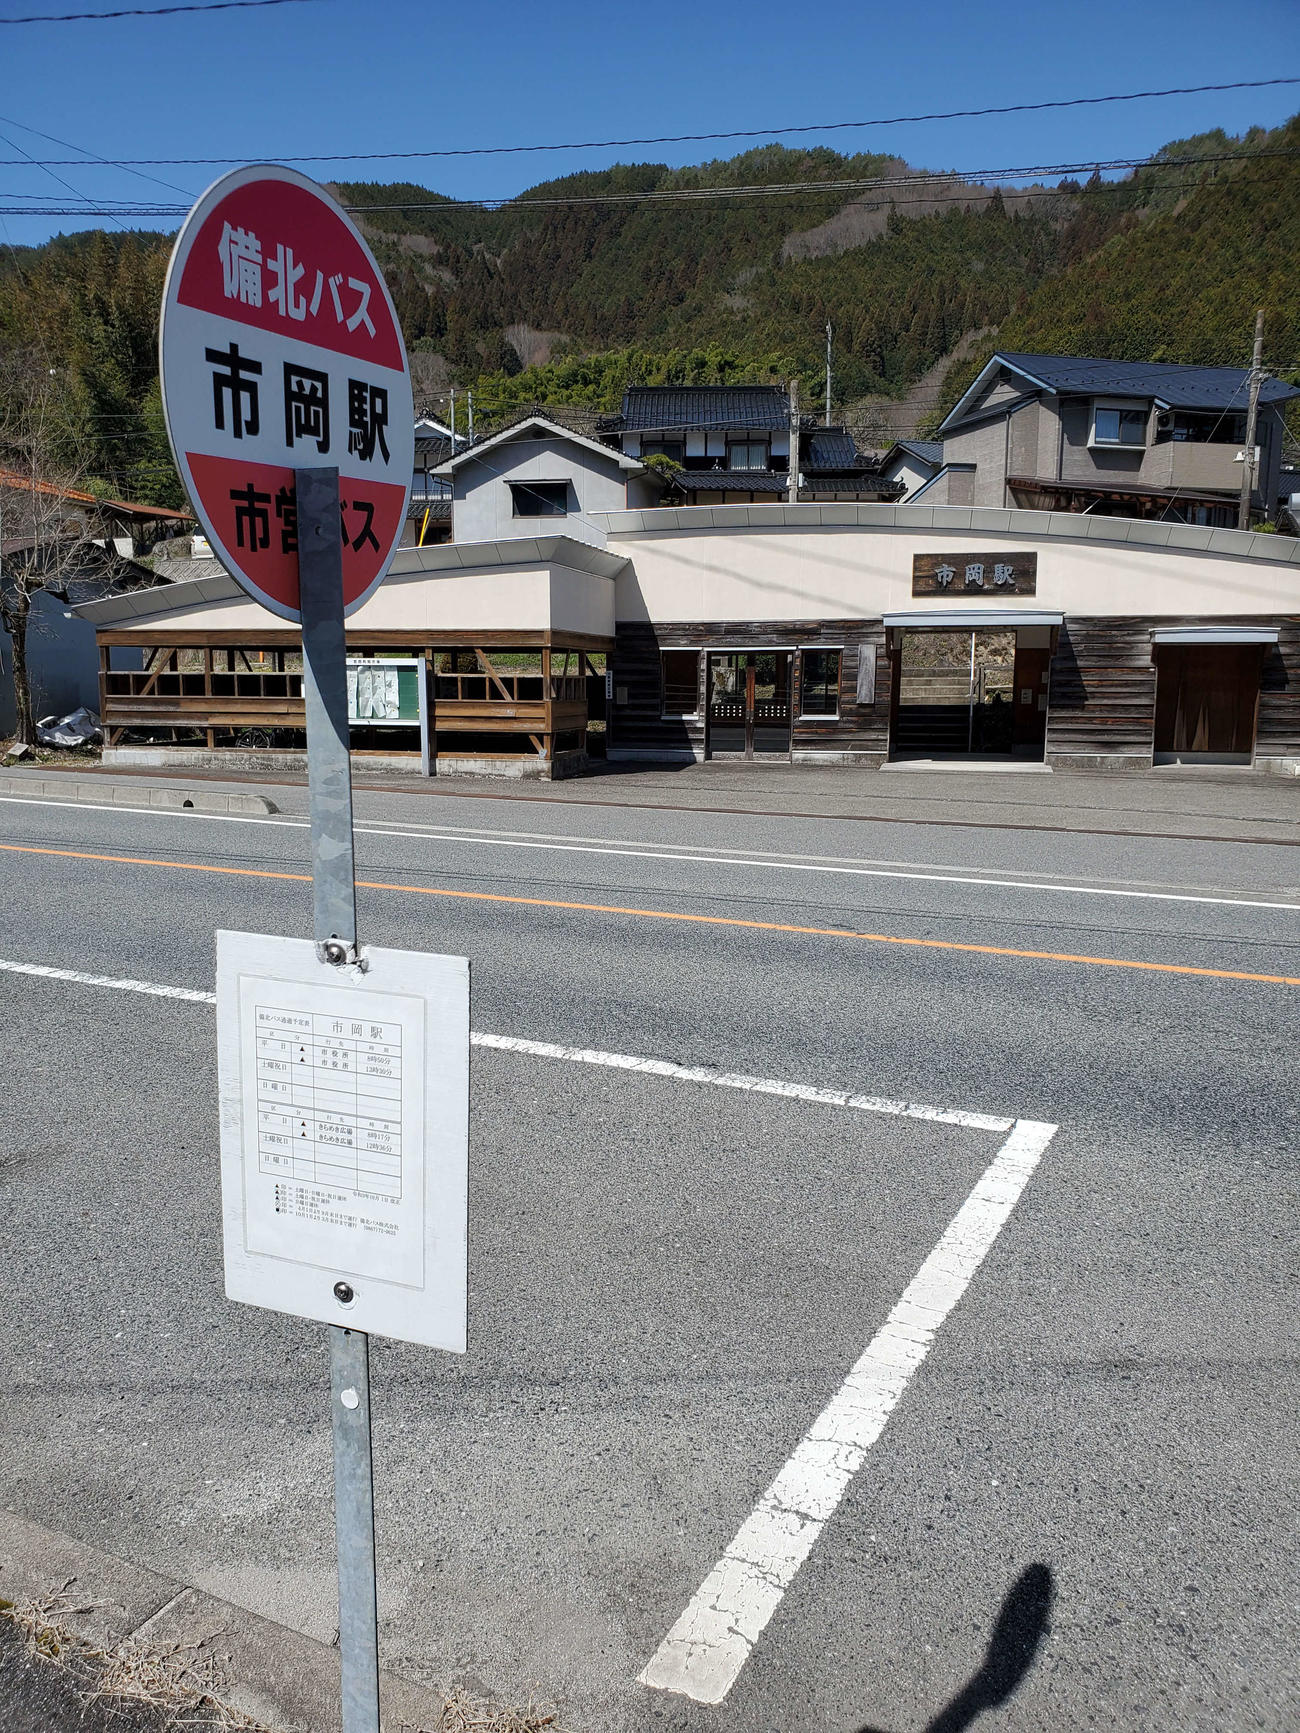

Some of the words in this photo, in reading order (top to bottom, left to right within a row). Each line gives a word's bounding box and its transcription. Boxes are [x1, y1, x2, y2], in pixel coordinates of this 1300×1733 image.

[218, 220, 376, 339] 備北バス
[205, 342, 390, 466] 市岡駅
[934, 563, 1015, 587] 市岡駅
[332, 1021, 383, 1040] 市岡駅
